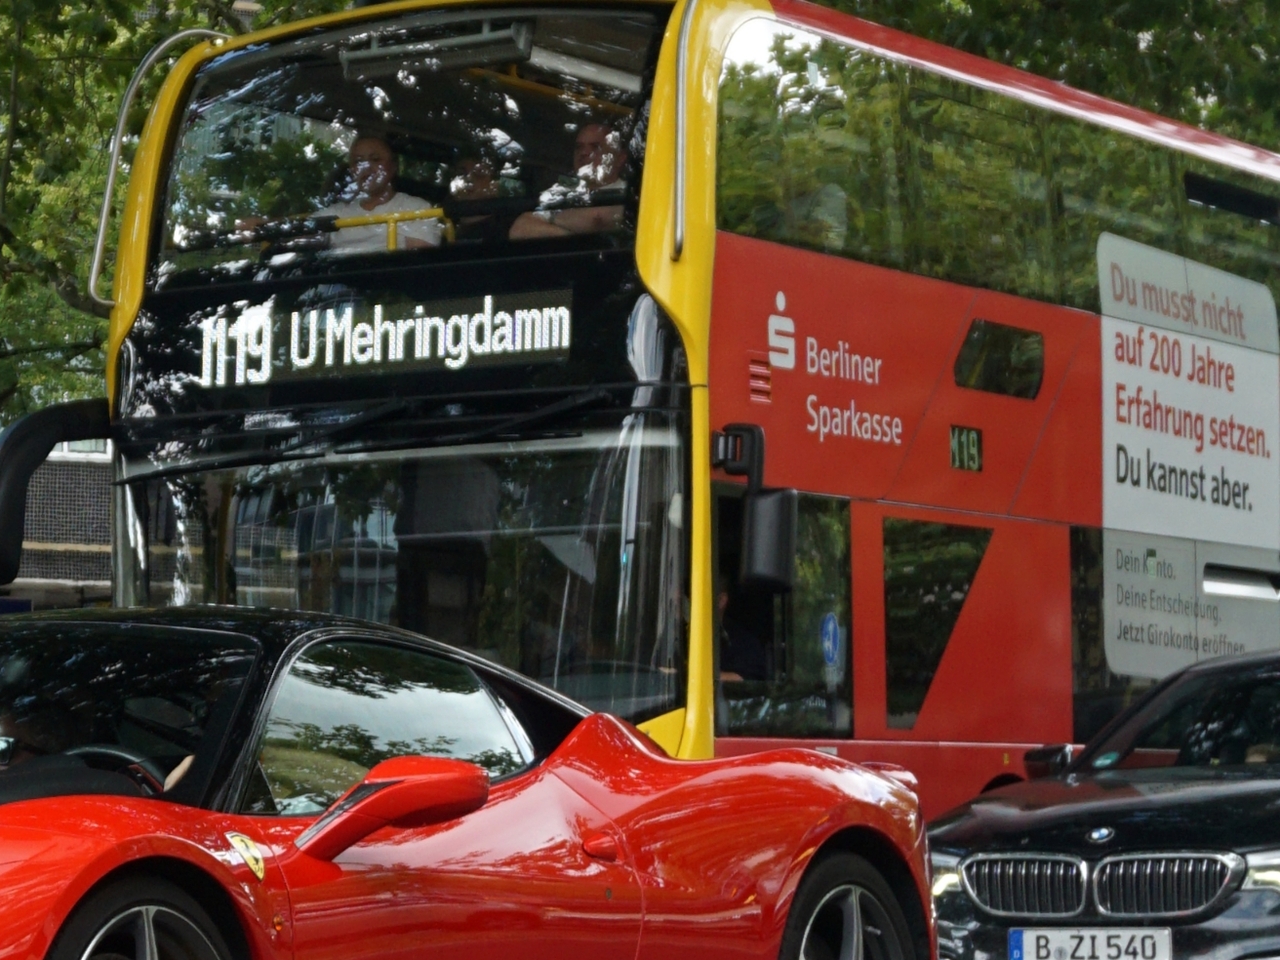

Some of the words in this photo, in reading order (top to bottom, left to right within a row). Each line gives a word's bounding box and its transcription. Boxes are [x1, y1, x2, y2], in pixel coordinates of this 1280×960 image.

[1110, 262, 1137, 306] Du
[1141, 280, 1198, 326] musst
[1202, 292, 1246, 340] nicht
[200, 316, 273, 388] M19
[291, 309, 317, 368] U
[324, 295, 570, 369] Mehringdamm
[806, 336, 882, 384] Berliner
[1115, 326, 1144, 367] auf
[1149, 332, 1182, 378] 200
[1187, 344, 1235, 392] Jahre
[806, 394, 902, 444] Sparkasse
[1116, 382, 1204, 453] Erfahrung
[1210, 414, 1271, 459] setzen.
[950, 425, 980, 471] M19
[1116, 443, 1141, 487] Du
[1147, 448, 1206, 501] kannst
[1211, 466, 1253, 512] aber.
[1116, 549, 1140, 574] Dein
[1143, 553, 1176, 580] Knto.
[1116, 584, 1147, 609] Deine
[1116, 619, 1144, 644] Jetzt
[1147, 624, 1199, 652] Girokonto
[1035, 935, 1051, 960] B
[1070, 935, 1100, 960] ZI
[1106, 935, 1156, 960] 540
